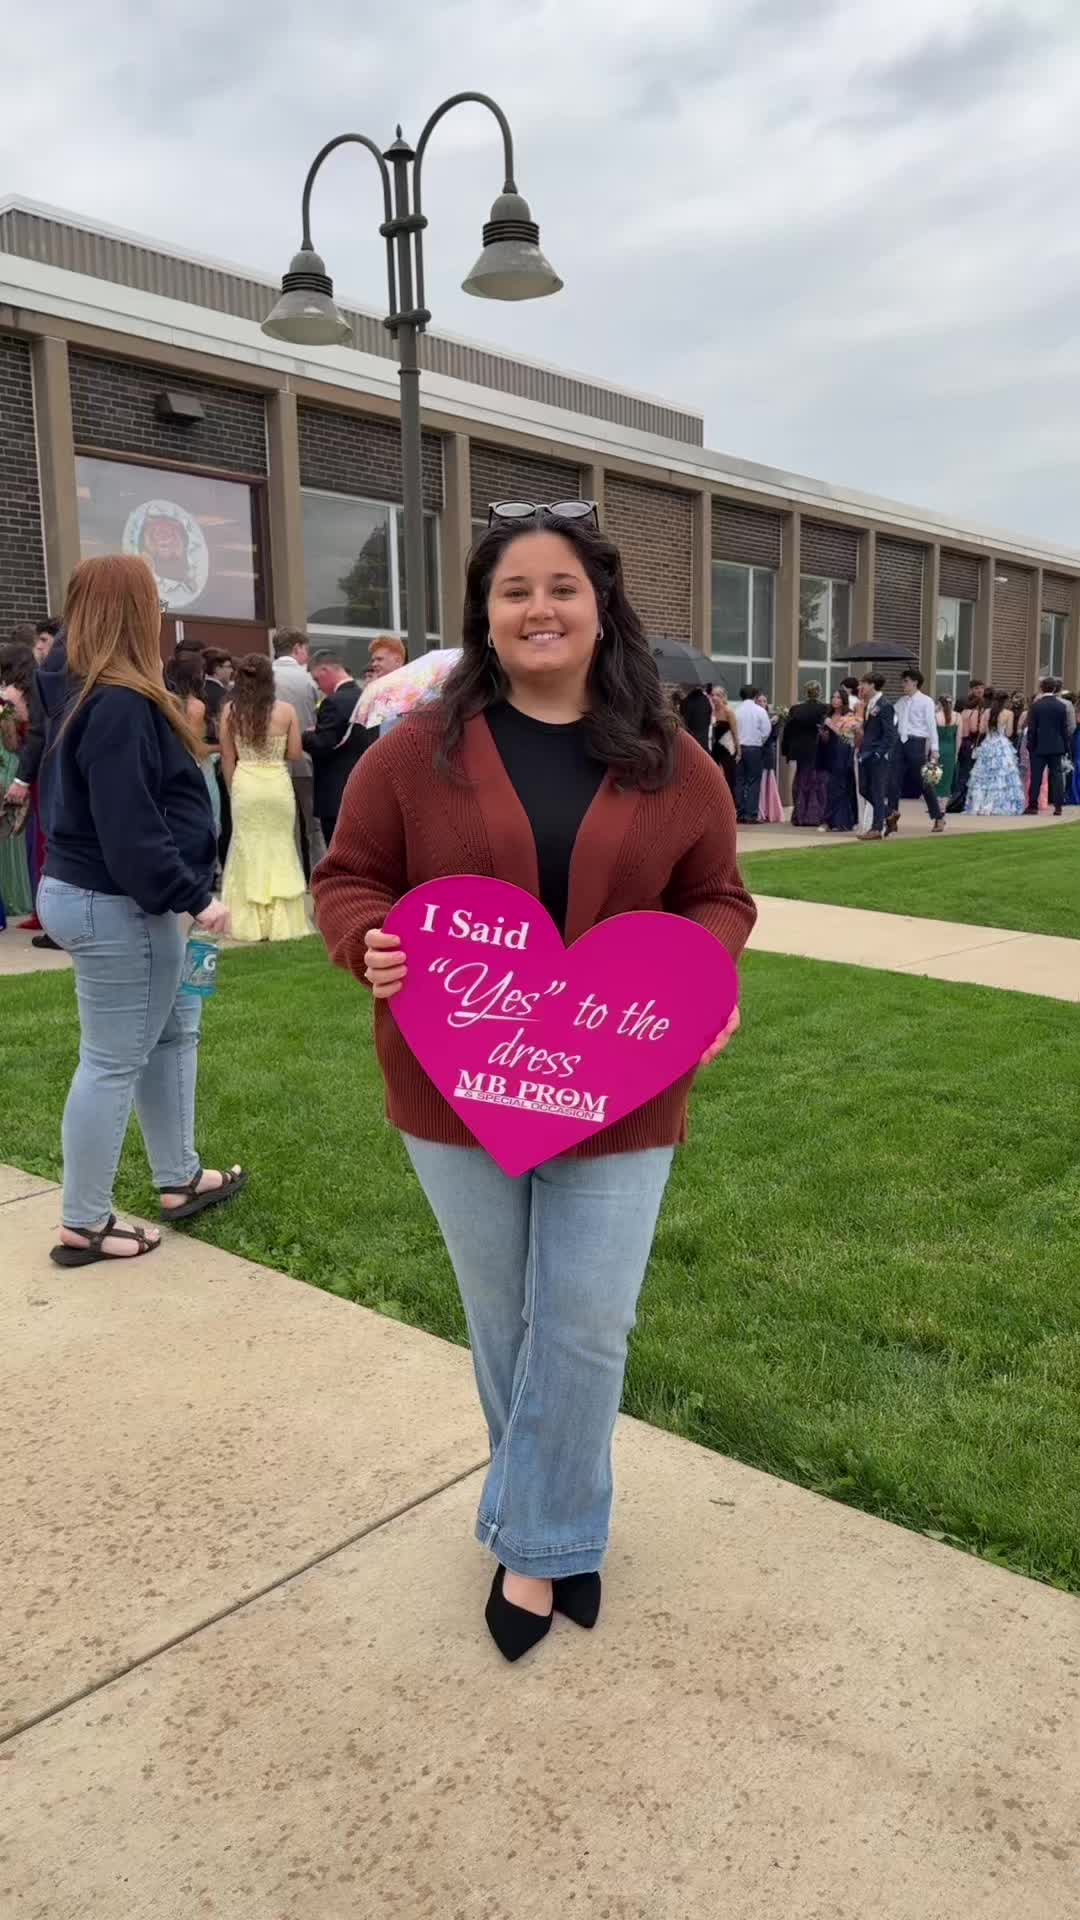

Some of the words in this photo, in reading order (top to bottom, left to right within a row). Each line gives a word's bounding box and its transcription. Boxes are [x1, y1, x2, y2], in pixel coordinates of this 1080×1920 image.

[420, 903, 440, 933] I
[448, 909, 530, 950] Said
[573, 993, 609, 1031] to
[616, 999, 670, 1041] the
[488, 1027, 581, 1078] dress
[456, 1069, 507, 1095] MB
[515, 1080, 608, 1113] PROM
[464, 1090, 473, 1098] &
[476, 1092, 530, 1108] SPECIAL
[530, 1102, 595, 1120] OCCASION
